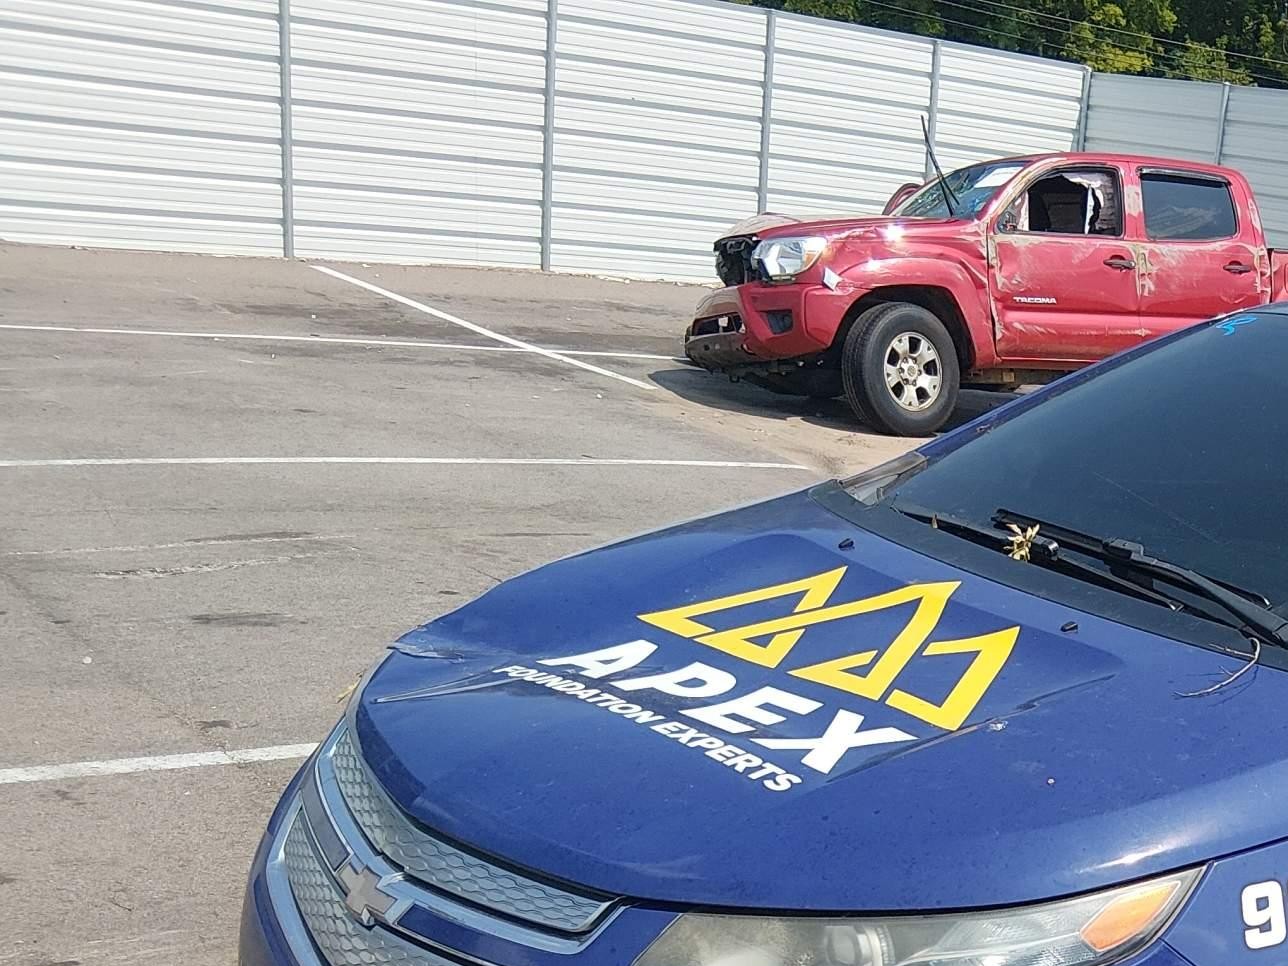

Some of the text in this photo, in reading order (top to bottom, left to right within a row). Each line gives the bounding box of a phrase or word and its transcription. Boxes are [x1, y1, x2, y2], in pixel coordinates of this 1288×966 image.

[1013, 296, 1057, 305] TACOMA
[493, 665, 802, 792] FOUNDATION EXPERTS
[536, 639, 919, 774] APEX
